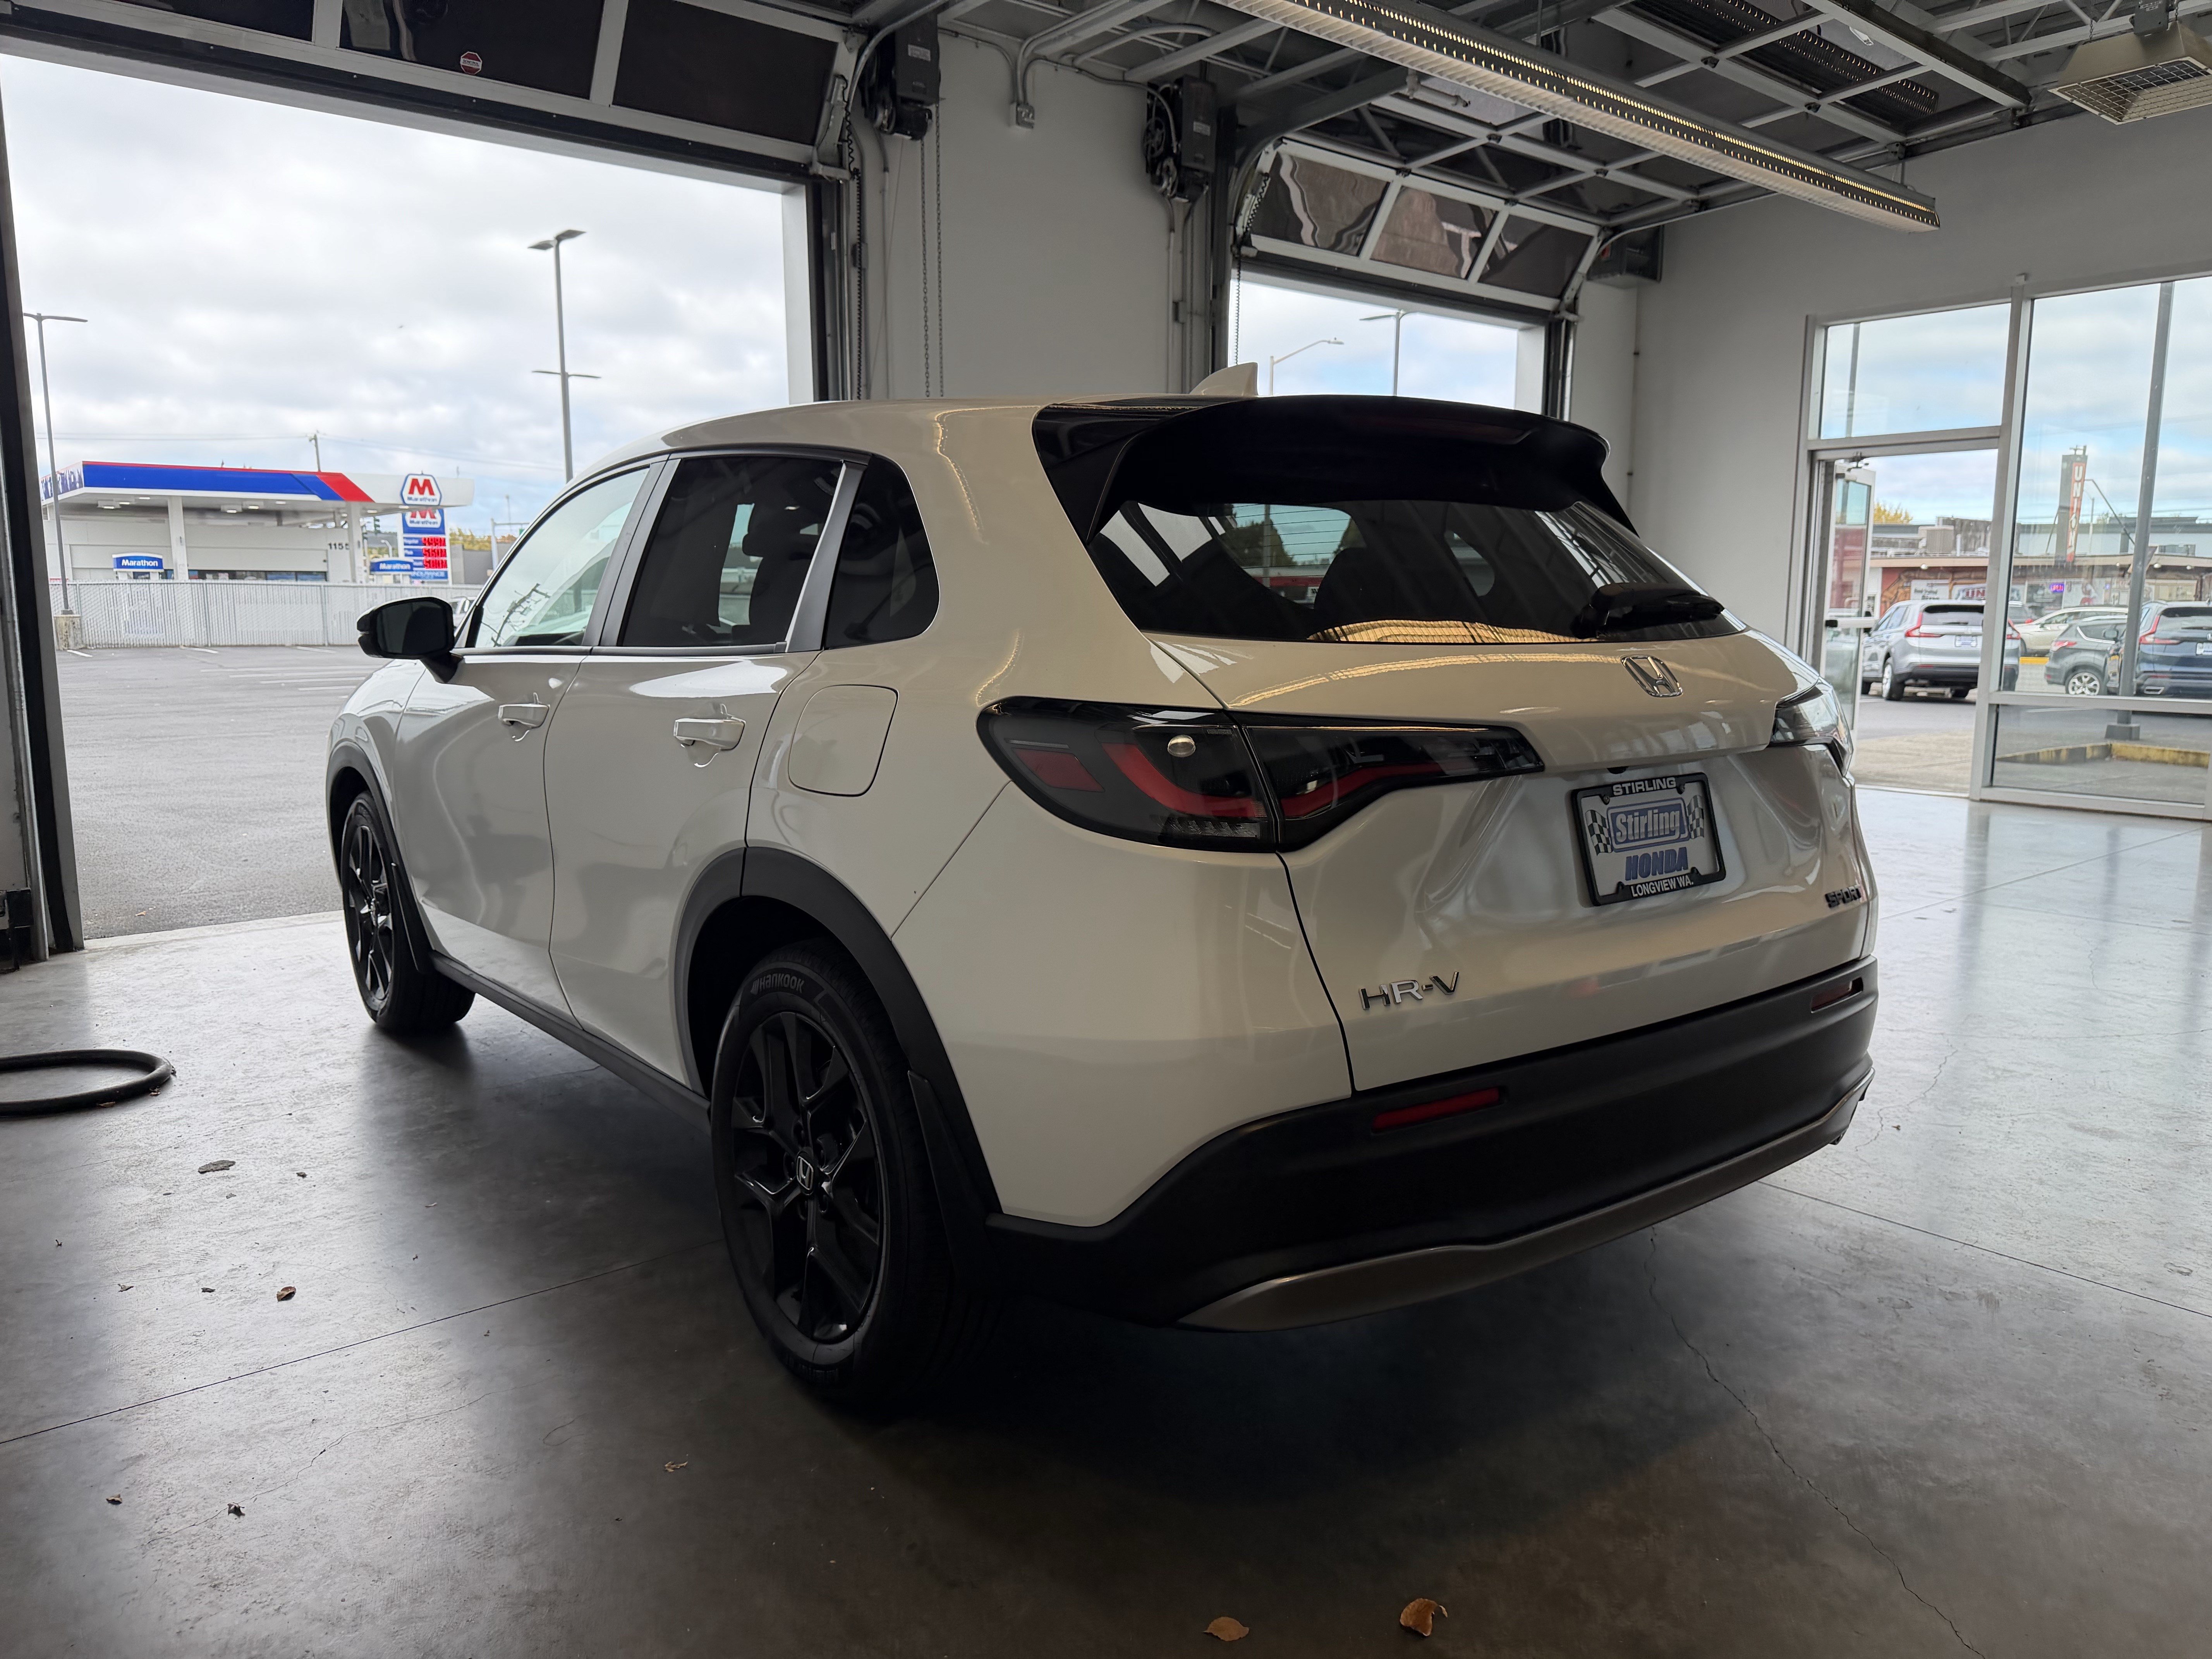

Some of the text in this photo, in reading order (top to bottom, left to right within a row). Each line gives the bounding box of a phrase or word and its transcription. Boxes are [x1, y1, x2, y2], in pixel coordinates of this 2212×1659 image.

[408, 478, 434, 496] M
[2069, 465, 2083, 547] UNION
[1613, 777, 1676, 796] STIRLING
[1616, 809, 1680, 842] Stirling
[1625, 847, 1688, 881] HONDA
[1631, 875, 1694, 897] LONGVIEW WA.
[1358, 971, 1459, 1010] HR-V
